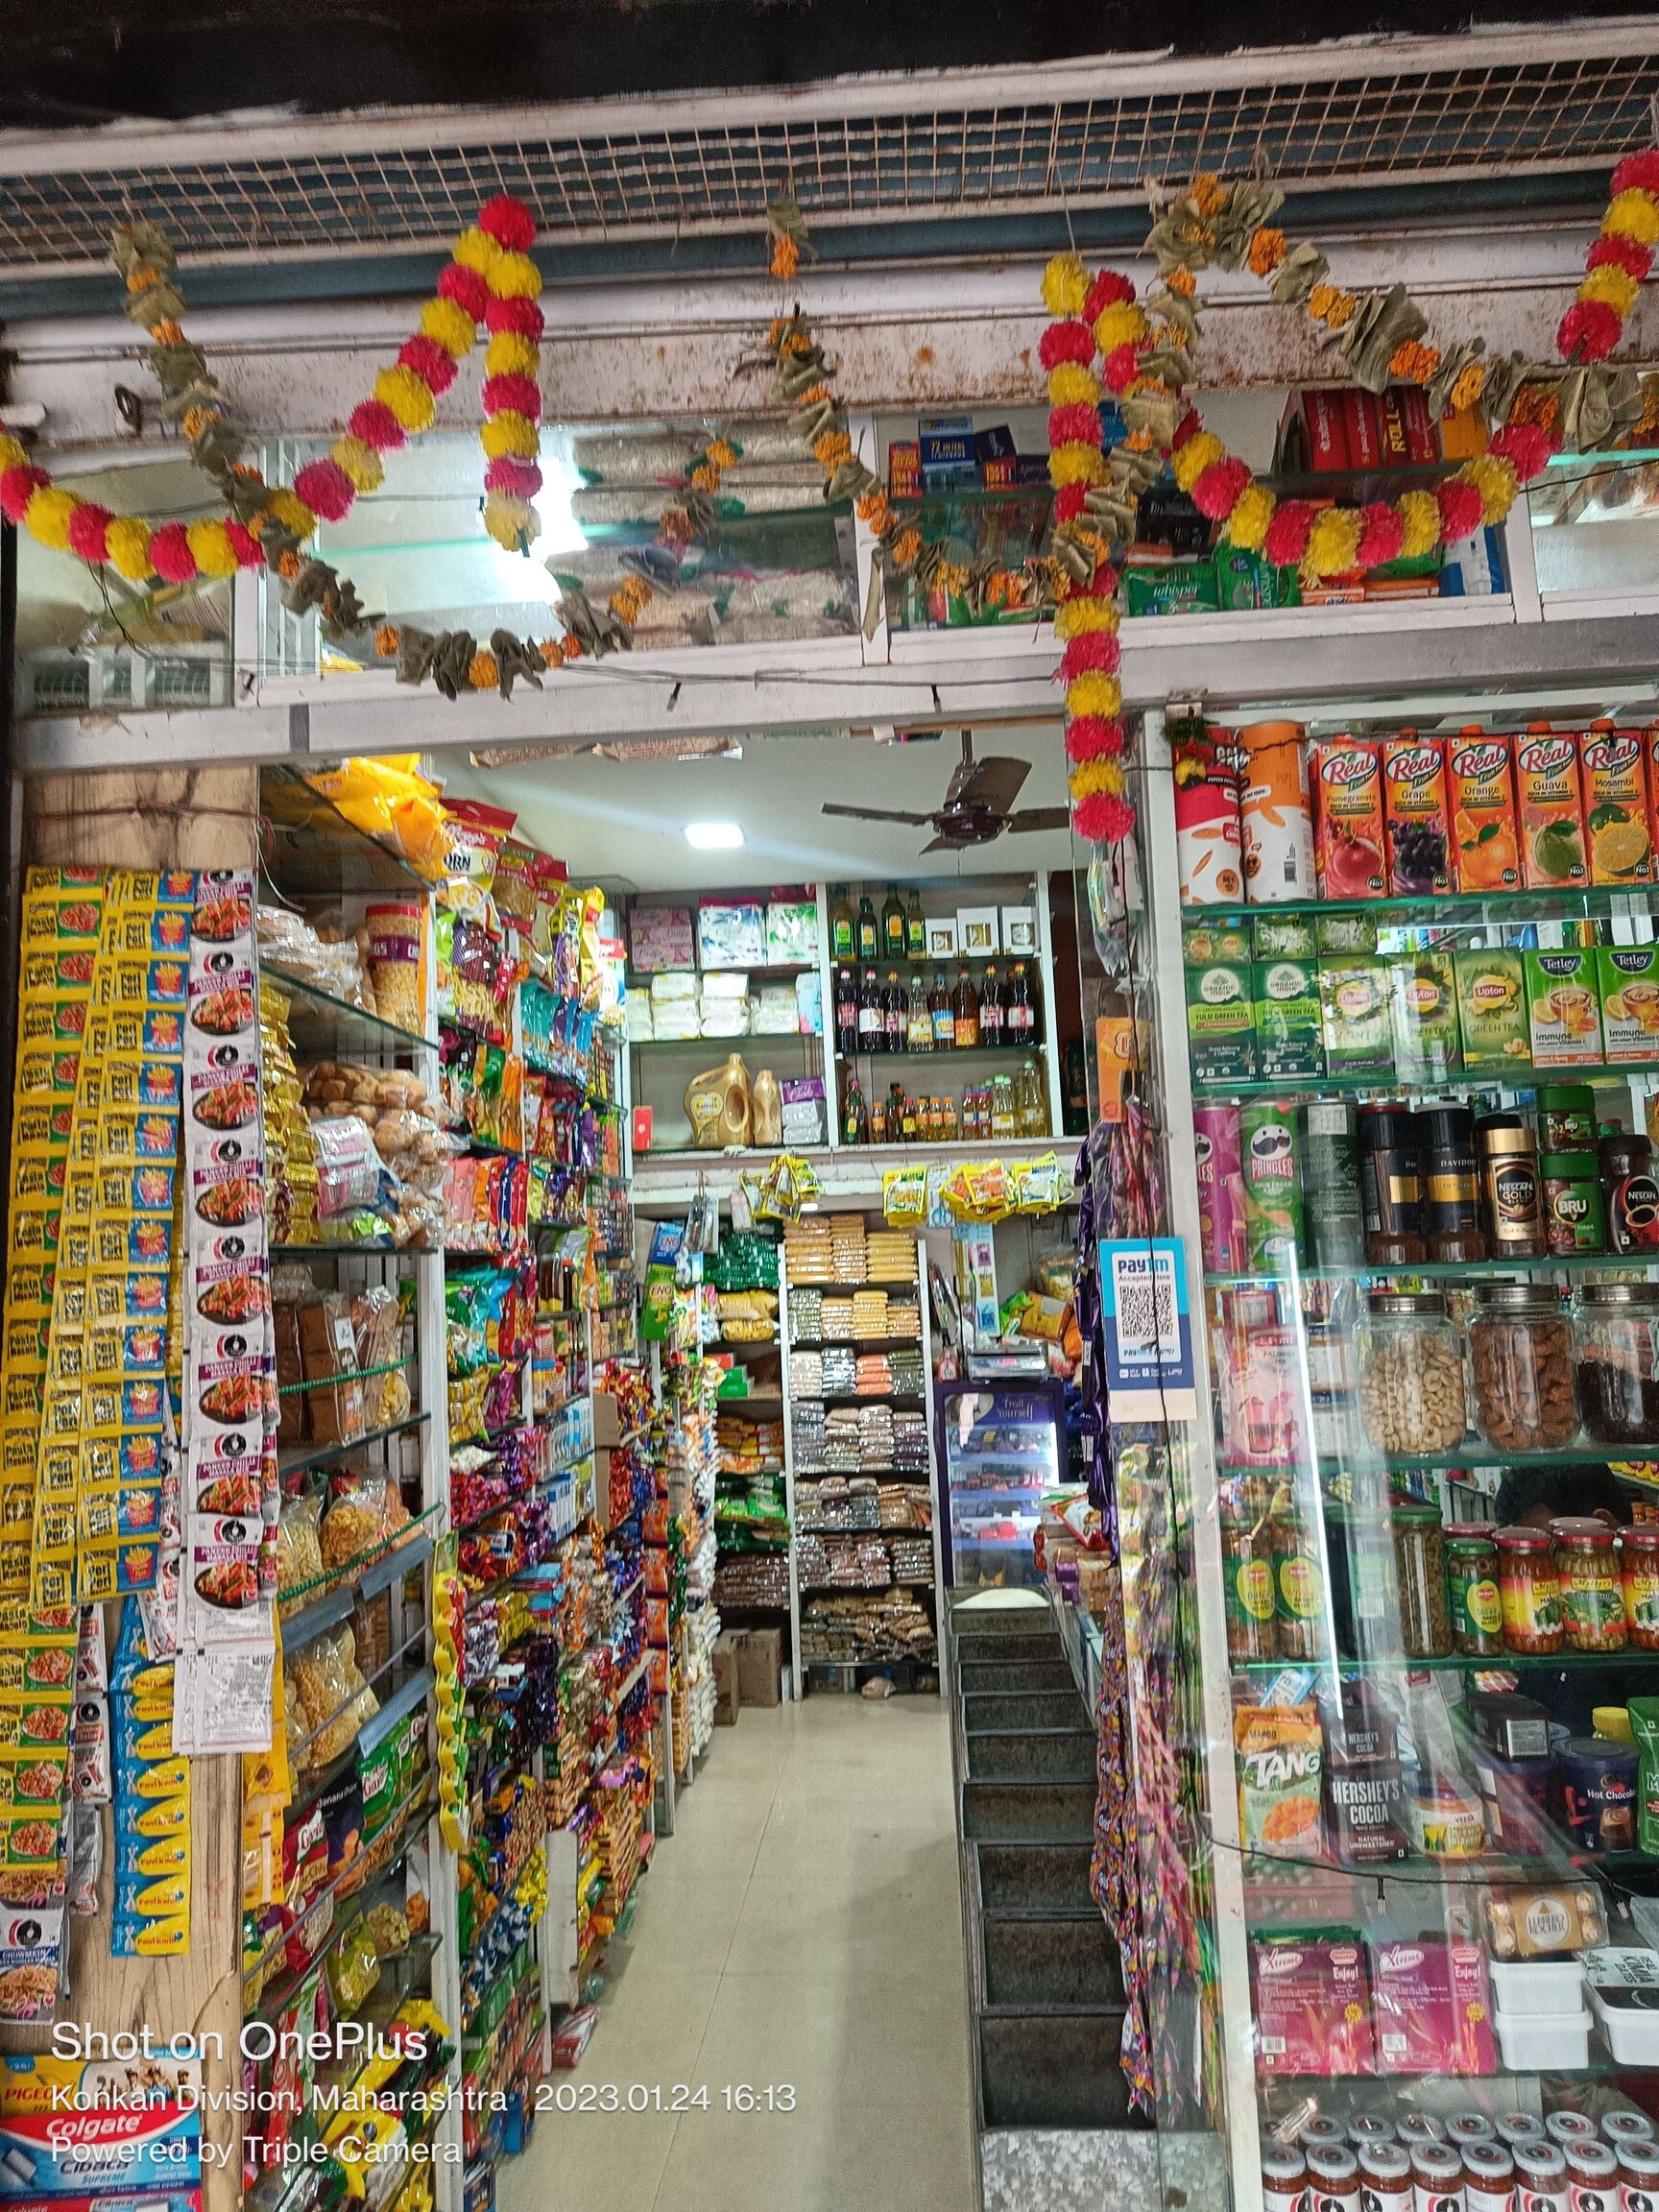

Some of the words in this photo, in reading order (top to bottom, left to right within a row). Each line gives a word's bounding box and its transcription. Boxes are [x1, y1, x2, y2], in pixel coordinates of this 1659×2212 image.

[1460, 747, 1503, 779] Real
[1527, 743, 1570, 774] Real
[1329, 753, 1374, 785] Real
[1394, 750, 1437, 782] Real
[1533, 781, 1568, 791] Guava
[1595, 778, 1634, 787] Mosambi
[1402, 790, 1431, 802] Grape
[1464, 785, 1500, 798] Orange
[1544, 958, 1576, 972] Tetley
[1617, 954, 1648, 968] Tetley
[1478, 986, 1504, 998] Lipton
[1469, 1024, 1500, 1033] GREEN
[1501, 1022, 1521, 1032] TEA
[1609, 1029, 1647, 1038] Immune
[1536, 1033, 1573, 1042] Immune
[1251, 1158, 1294, 1179] PRINGLES
[1503, 1190, 1532, 1200] GOLD
[1558, 1200, 1587, 1214] BRU
[660, 1236, 679, 1244] ENO
[651, 1286, 672, 1295] ENO
[998, 1404, 1033, 1421] Yourself
[1250, 1730, 1277, 1740] MANGO
[1348, 1732, 1380, 1744] HERSHEY'S
[1357, 1743, 1374, 1753] COCOA
[1245, 1750, 1320, 1790] TANG
[1332, 1778, 1400, 1805] HERSHEY'S
[1587, 1789, 1604, 1799] Hot
[1350, 1804, 1389, 1825] COCOA
[1349, 1840, 1395, 1850] UNSWEETENED
[1333, 1965, 1358, 1982] Enjoy!
[1455, 1963, 1480, 1980] Enjoy!
[46, 2114, 143, 2141] Colgate
[82, 2173, 127, 2184] SUPREME
